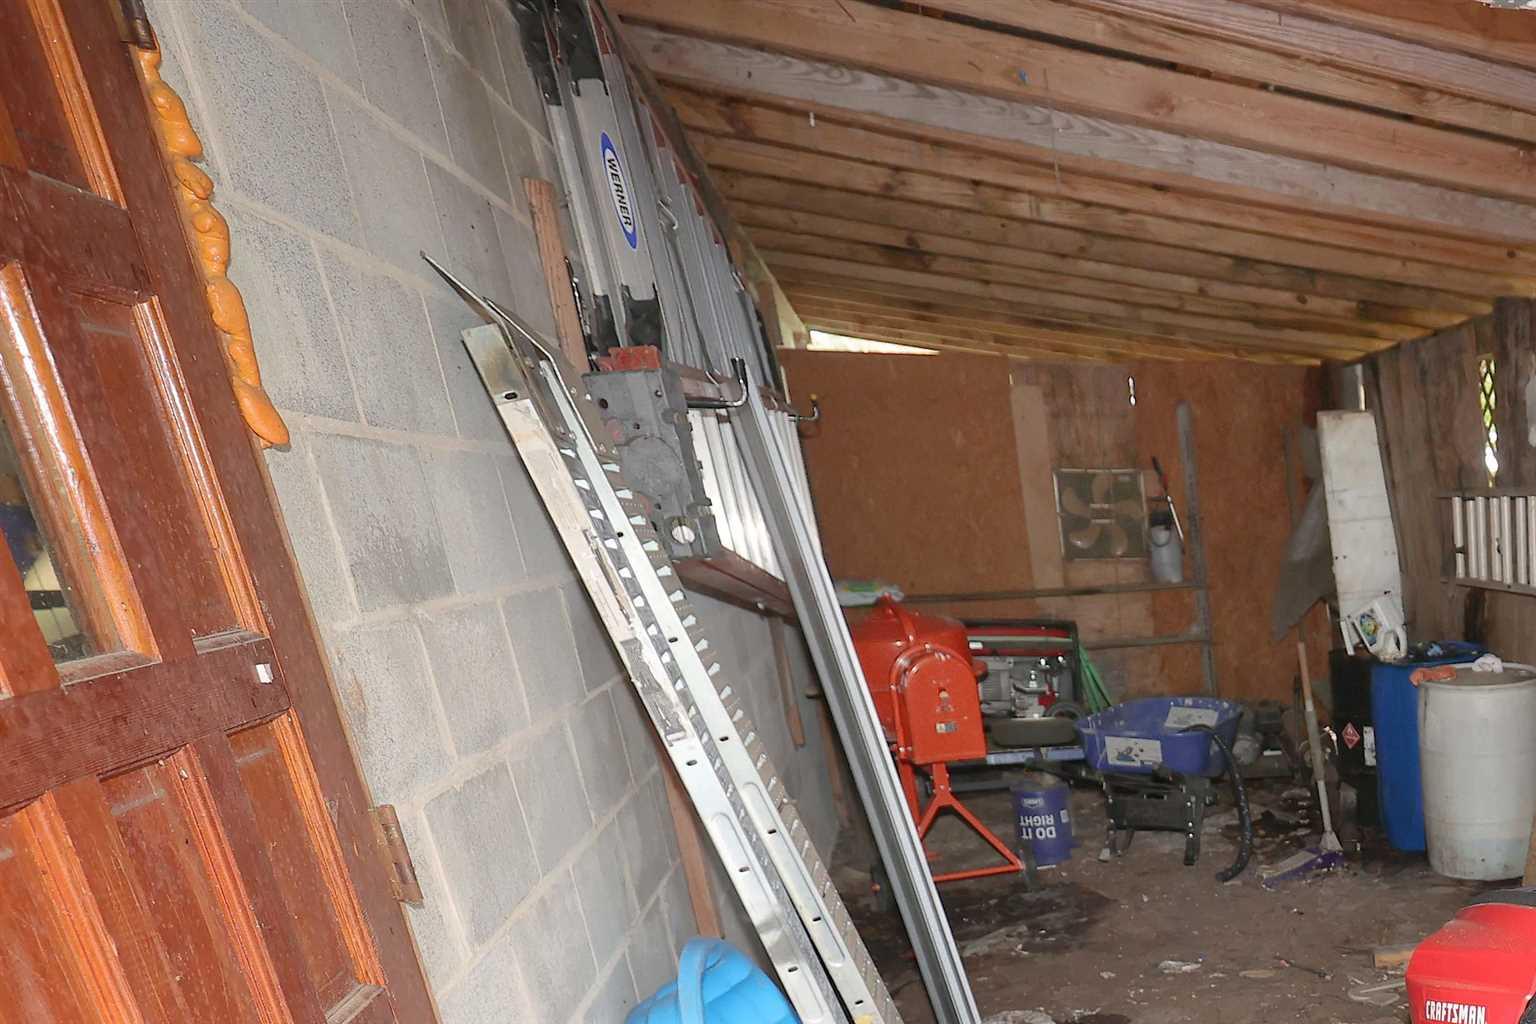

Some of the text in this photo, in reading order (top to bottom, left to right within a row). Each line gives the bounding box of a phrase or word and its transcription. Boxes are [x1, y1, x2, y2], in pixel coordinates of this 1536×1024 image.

[607, 157, 632, 227] WERNER
[1020, 814, 1055, 828] RIGHT
[1021, 826, 1057, 840] DO IT
